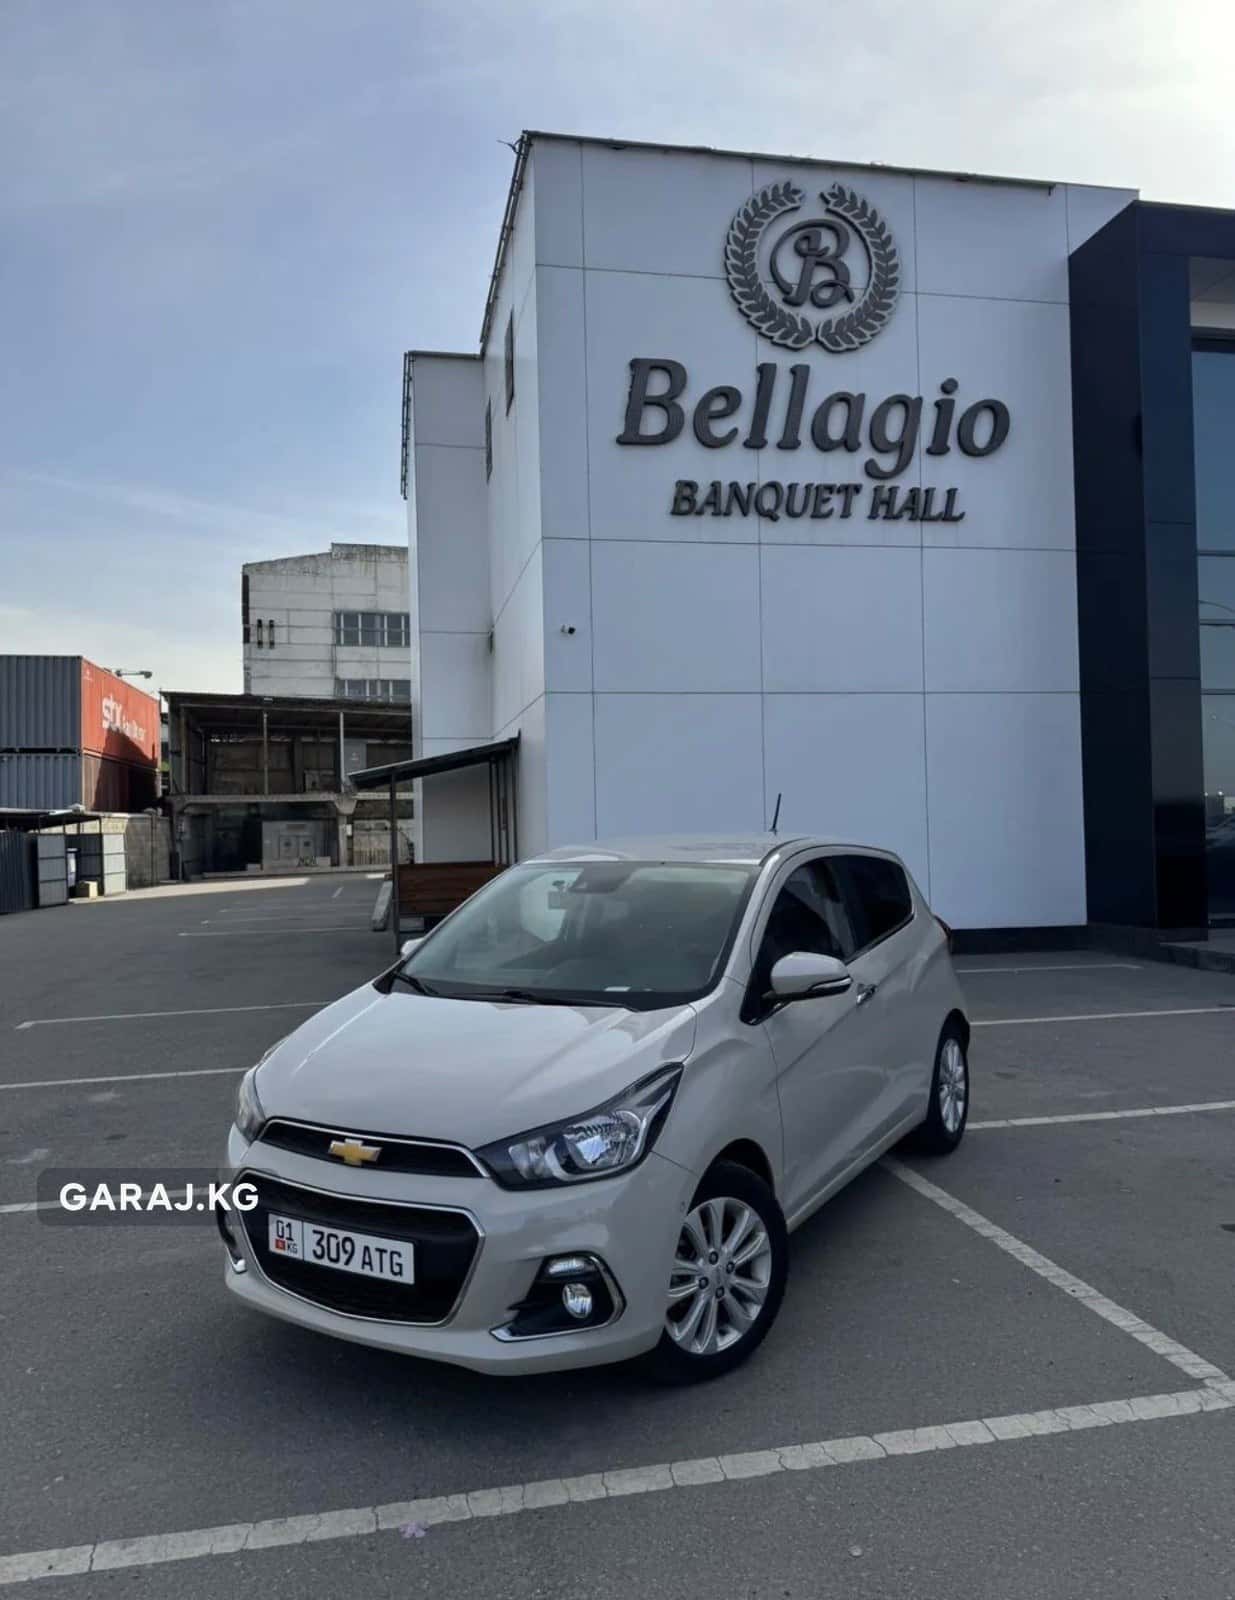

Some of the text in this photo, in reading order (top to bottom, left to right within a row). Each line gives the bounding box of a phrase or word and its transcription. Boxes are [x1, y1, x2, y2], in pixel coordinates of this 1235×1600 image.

[616, 357, 1011, 480] Bellagio
[670, 479, 966, 522] BANQUET HALL
[276, 1219, 294, 1242] 01
[287, 1241, 298, 1254] KG
[312, 1229, 403, 1277] 309 ATG
